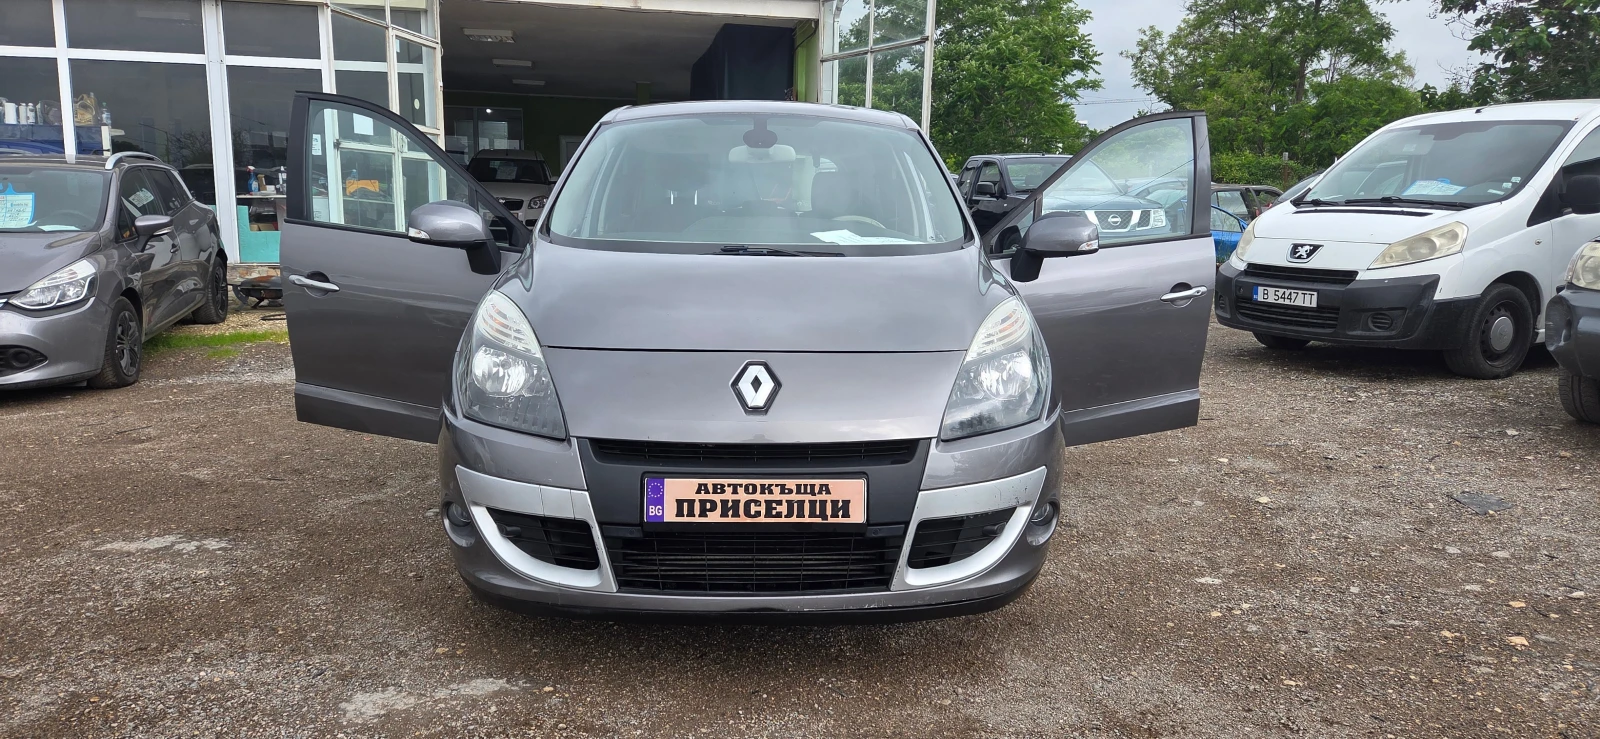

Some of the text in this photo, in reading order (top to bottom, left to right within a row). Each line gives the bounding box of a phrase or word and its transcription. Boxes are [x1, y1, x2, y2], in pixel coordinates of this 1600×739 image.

[1262, 289, 1315, 306] B 5447 TT
[695, 483, 831, 496] АВТОКЪЩА
[649, 505, 663, 516] BG
[675, 499, 851, 520] ПРИСЕЛЦИ
